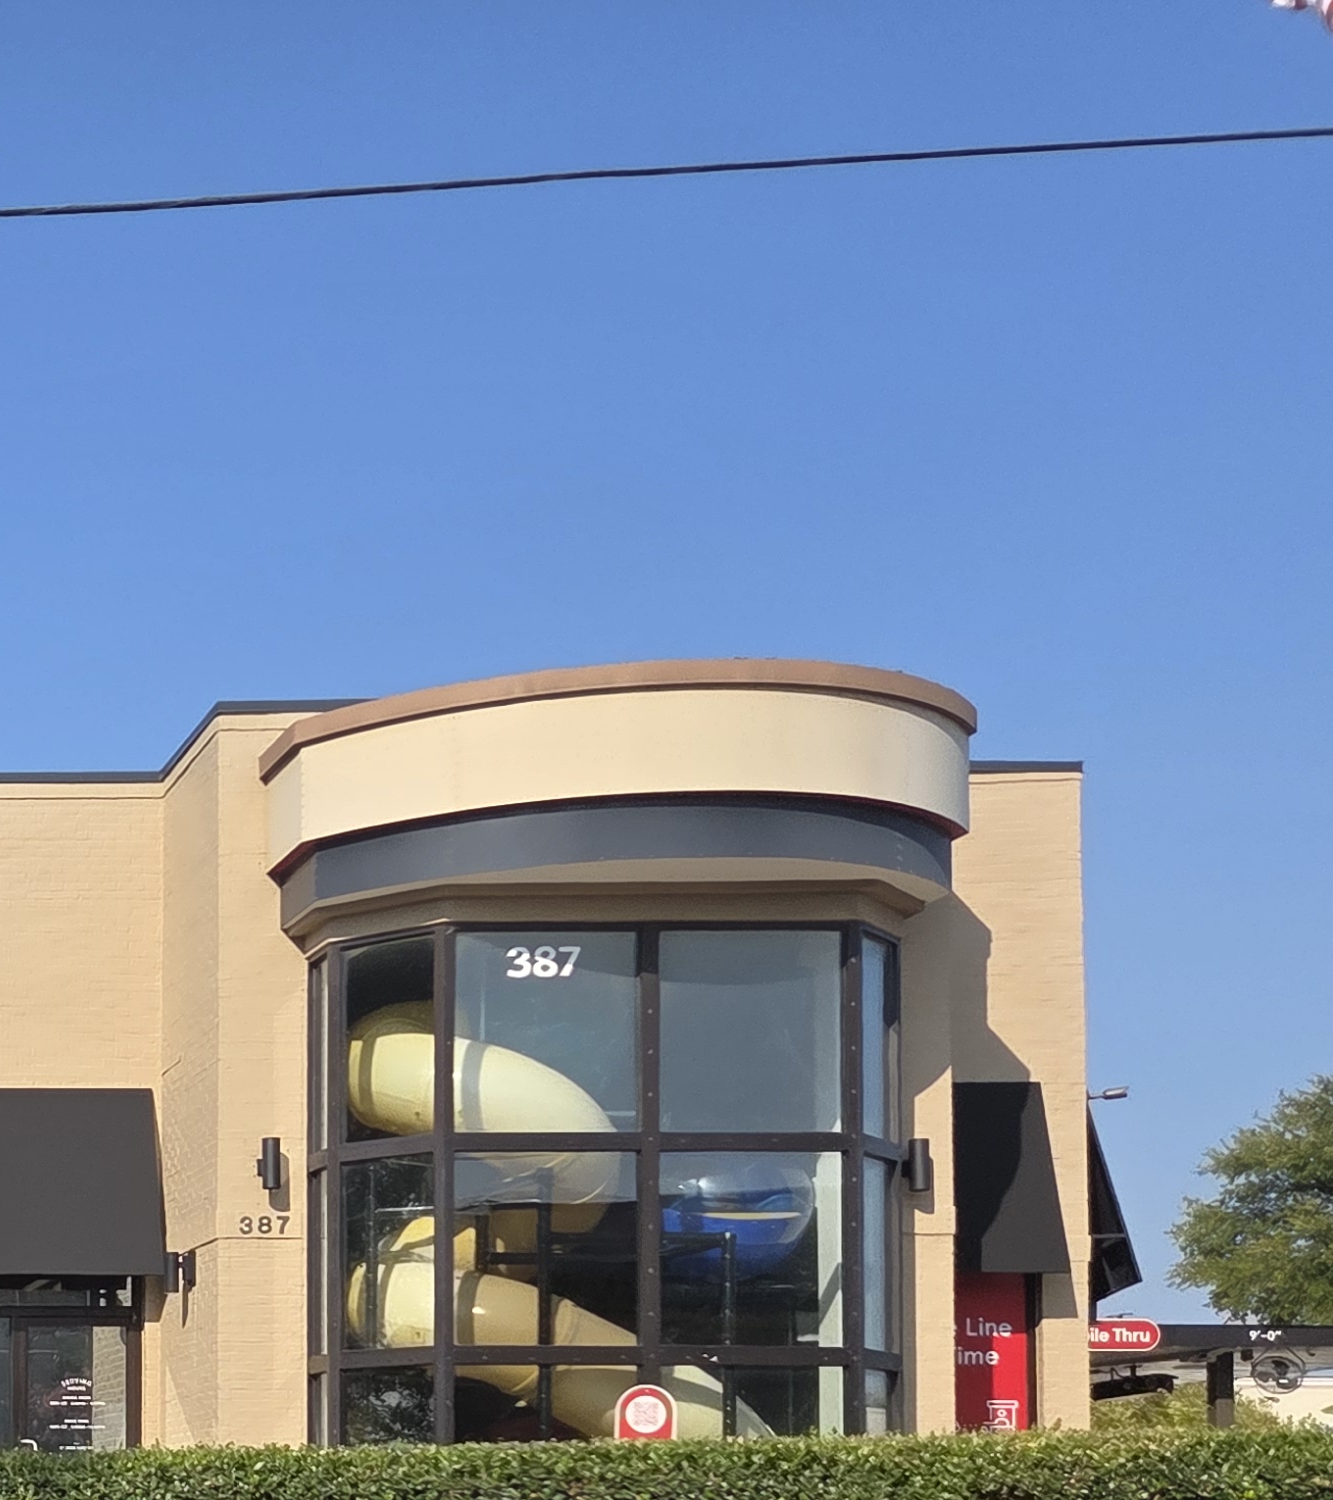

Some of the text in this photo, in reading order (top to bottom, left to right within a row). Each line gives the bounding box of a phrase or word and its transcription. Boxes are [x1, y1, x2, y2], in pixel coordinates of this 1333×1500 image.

[505, 945, 582, 978] 387
[239, 1215, 290, 1235] 387
[966, 1317, 1012, 1338] Line
[1089, 1327, 1151, 1343] ile Thru
[955, 1346, 1000, 1366] ime
